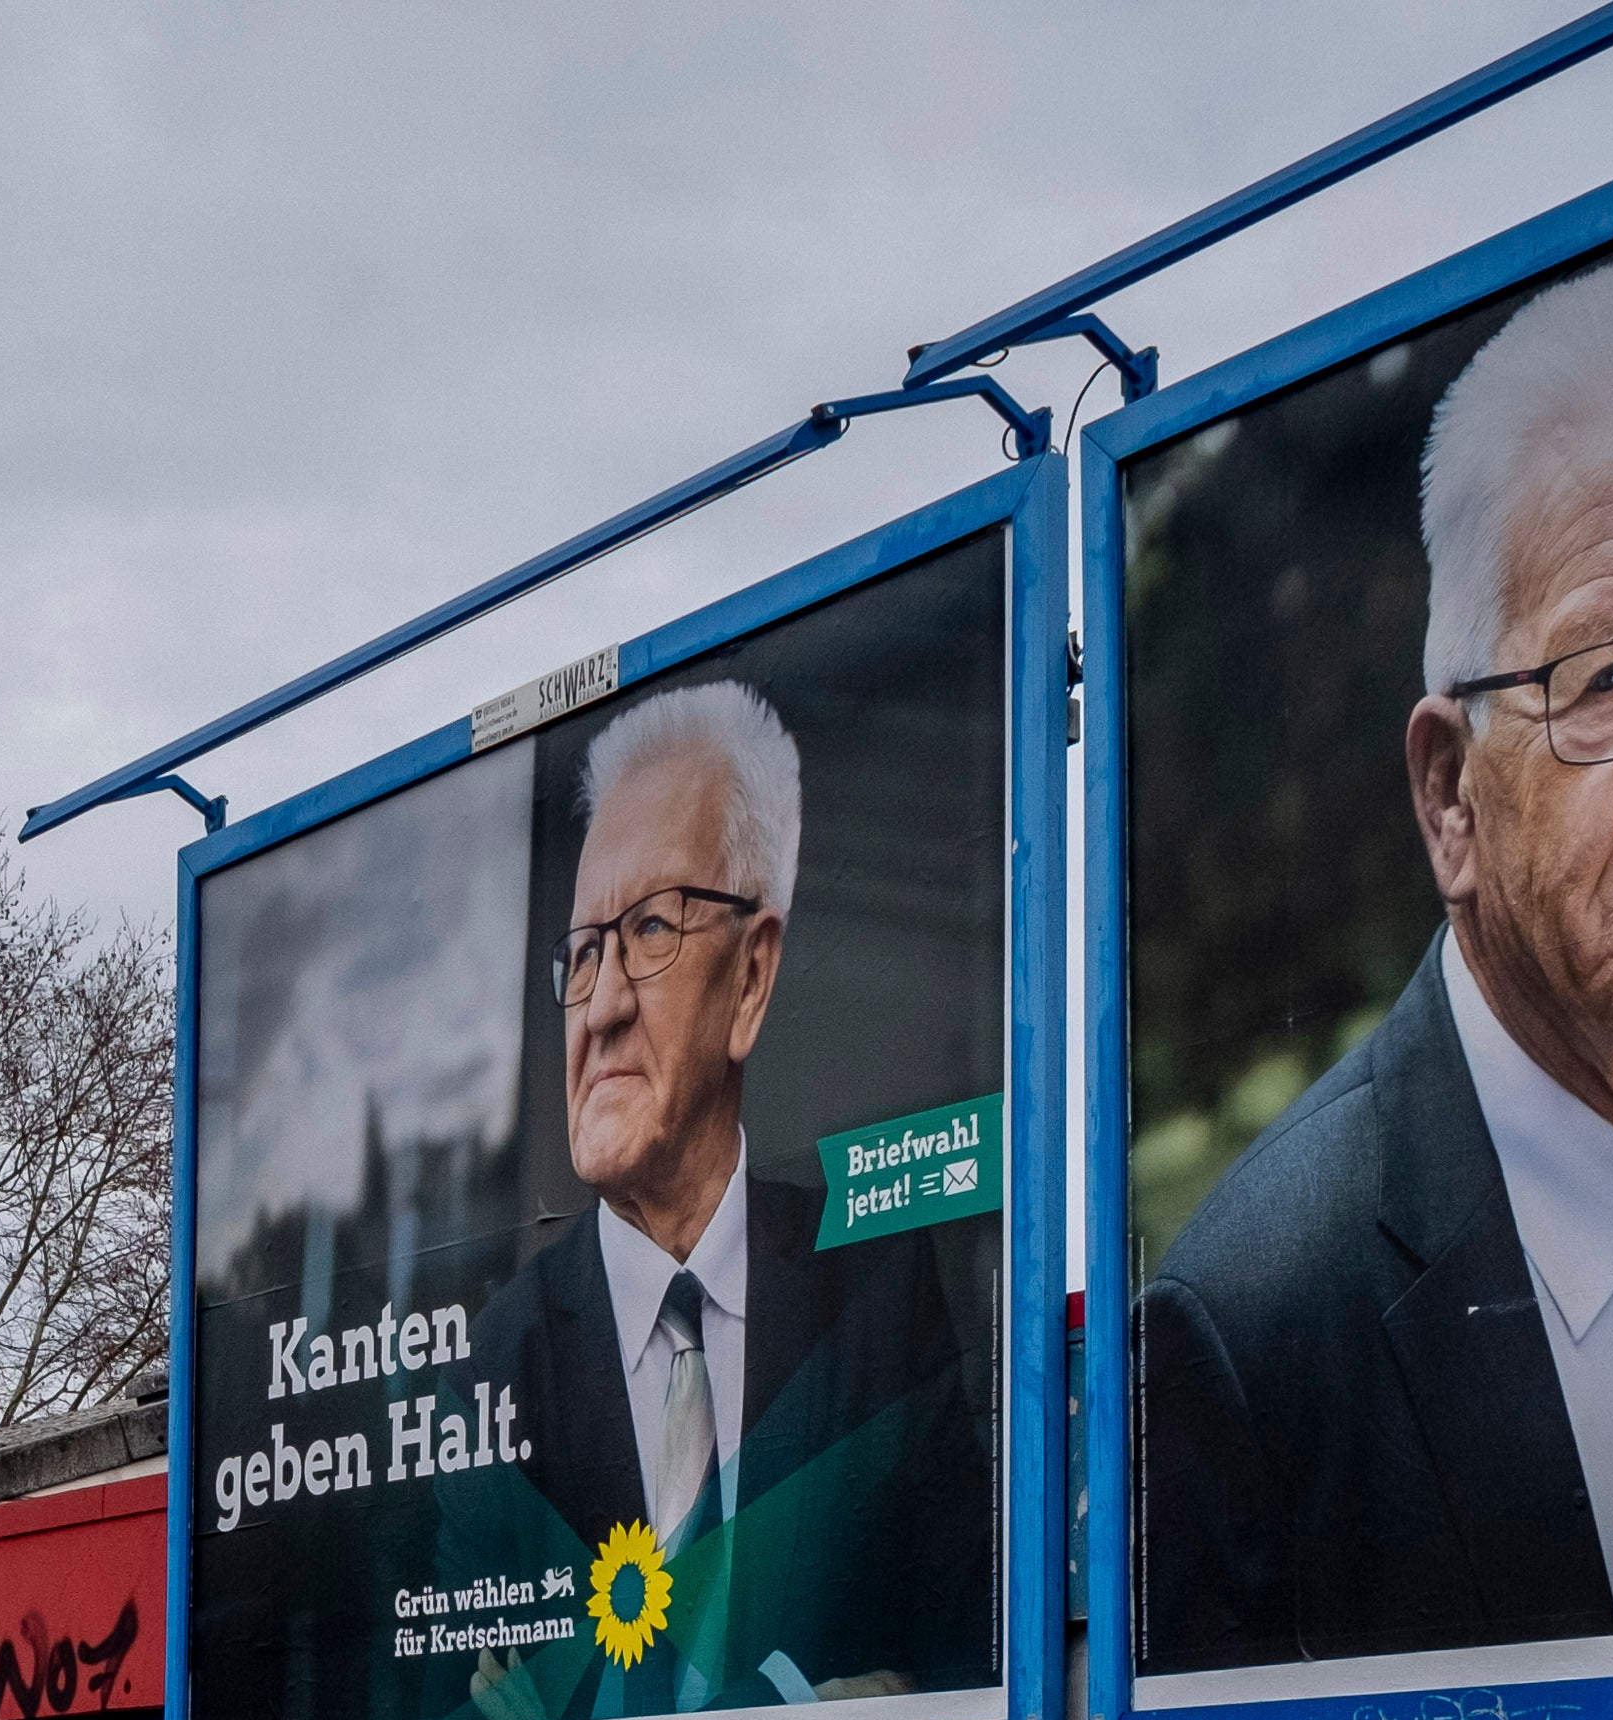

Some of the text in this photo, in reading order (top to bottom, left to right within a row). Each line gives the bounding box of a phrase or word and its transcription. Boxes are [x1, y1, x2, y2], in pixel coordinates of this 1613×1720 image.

[539, 652, 605, 708] SCHWARZ
[847, 1114, 980, 1179] Briefwahl
[846, 1171, 910, 1228] jetzt!
[267, 1301, 471, 1401] Kanten
[216, 1382, 533, 1533] geben Halt.
[394, 1576, 535, 1619] Grün wählen
[394, 1617, 574, 1658] für Kretschmann
